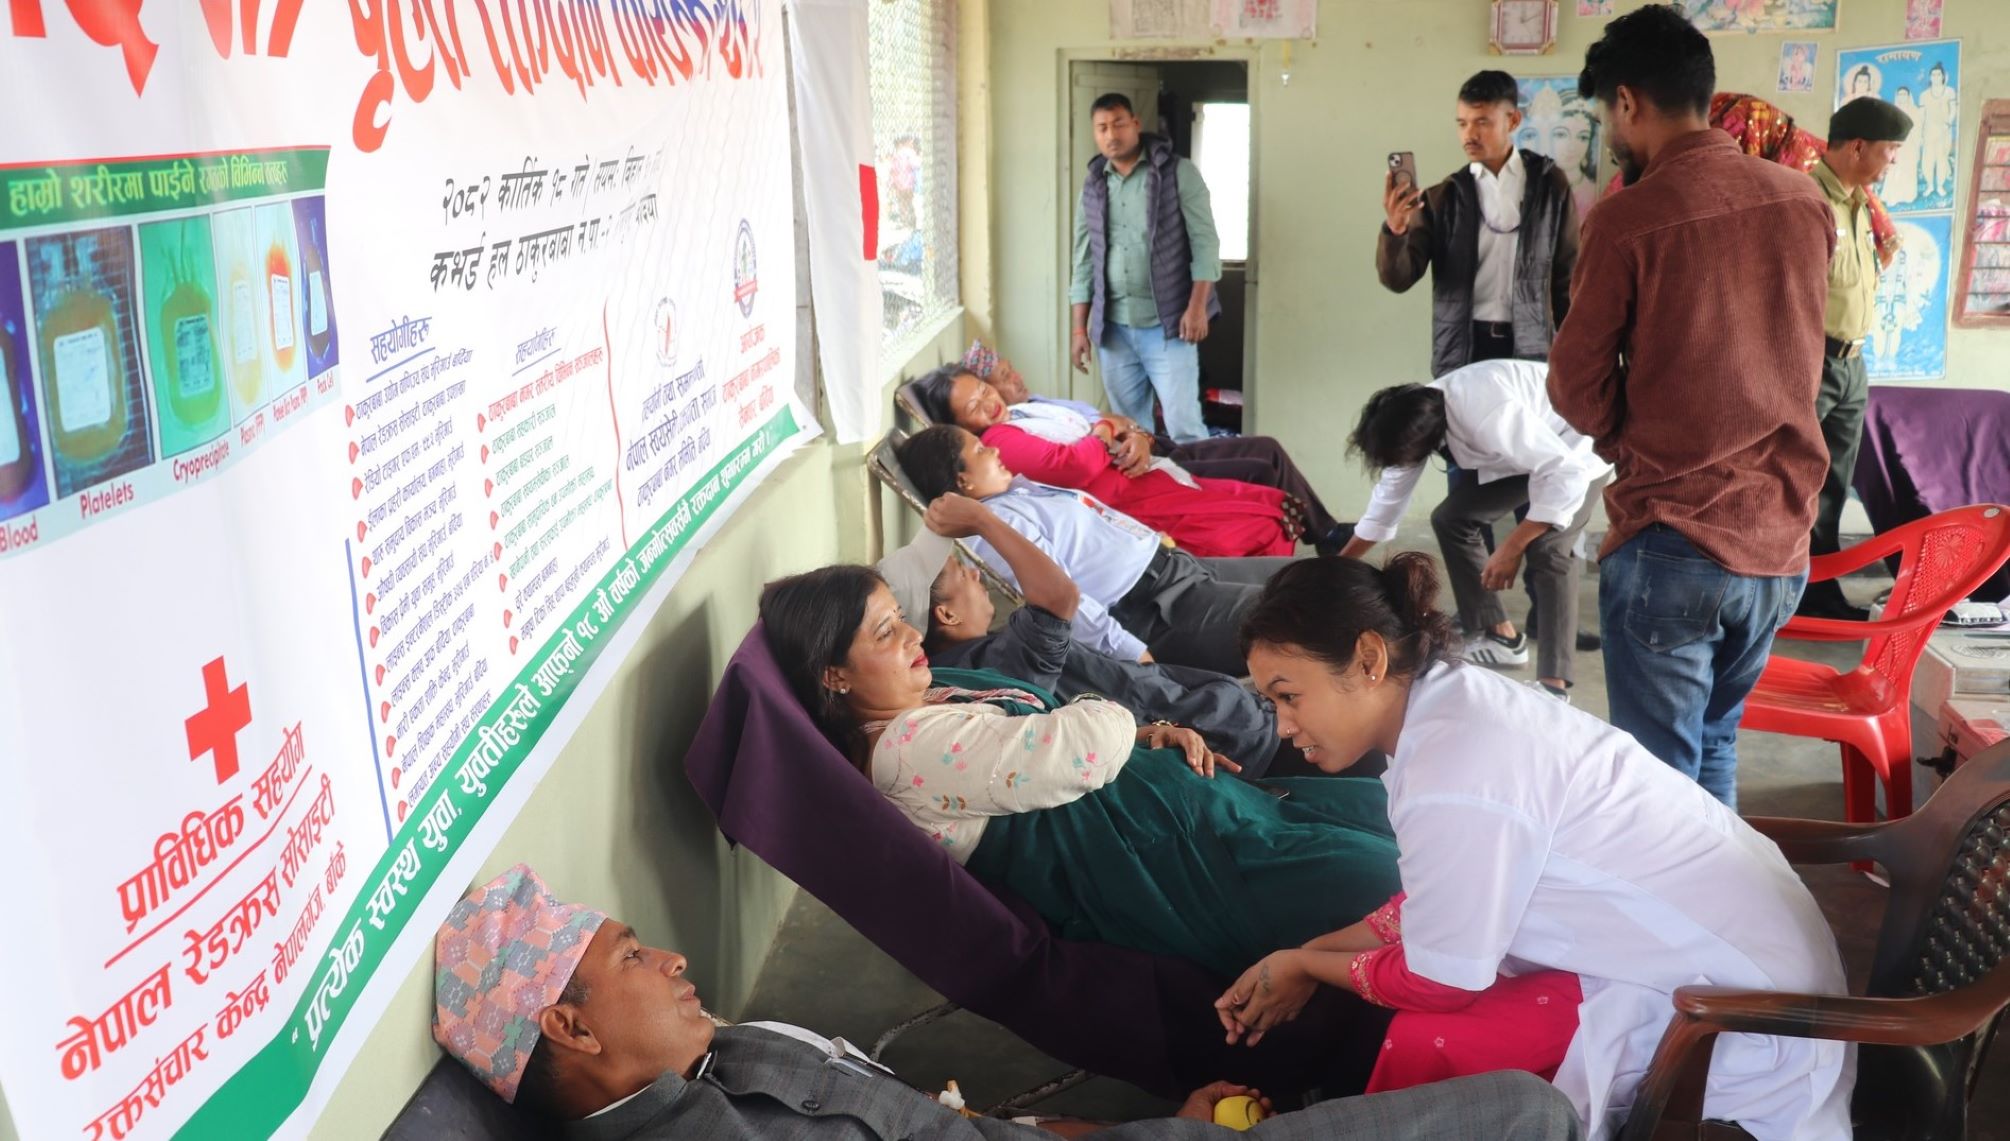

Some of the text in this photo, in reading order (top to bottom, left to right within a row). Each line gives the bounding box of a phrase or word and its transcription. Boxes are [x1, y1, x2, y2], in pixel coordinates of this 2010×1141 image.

[8, 168, 62, 215] हाम्रो
[70, 164, 144, 208] शरीरमा
[149, 158, 196, 201] पाईने
[442, 176, 491, 225] २०८२
[497, 155, 548, 213] कार्तिक
[570, 154, 590, 200] गते
[487, 240, 512, 291] हल
[516, 224, 575, 284] ठाकुरबाबा
[370, 315, 433, 365] सहयोगीहरु
[355, 390, 383, 419] ठाकुरबाबा
[360, 432, 377, 456] नेपाल
[626, 436, 649, 471] नेपाल
[80, 483, 134, 519] Platelets
[363, 463, 381, 494] रेडियो
[0, 515, 38, 552] Blood
[304, 918, 365, 1051] प्रत्येक
[365, 837, 421, 931] स्वस्थ
[417, 788, 462, 852] युवा,
[576, 612, 599, 641] १८
[608, 557, 640, 604] वर्षको
[690, 474, 722, 515] रक्तदान
[117, 721, 306, 935] प्राविधिक सहयोग
[55, 772, 337, 1081] नेपाल रेडक्रस सोसाइटी
[215, 969, 271, 1040] केन्द्र
